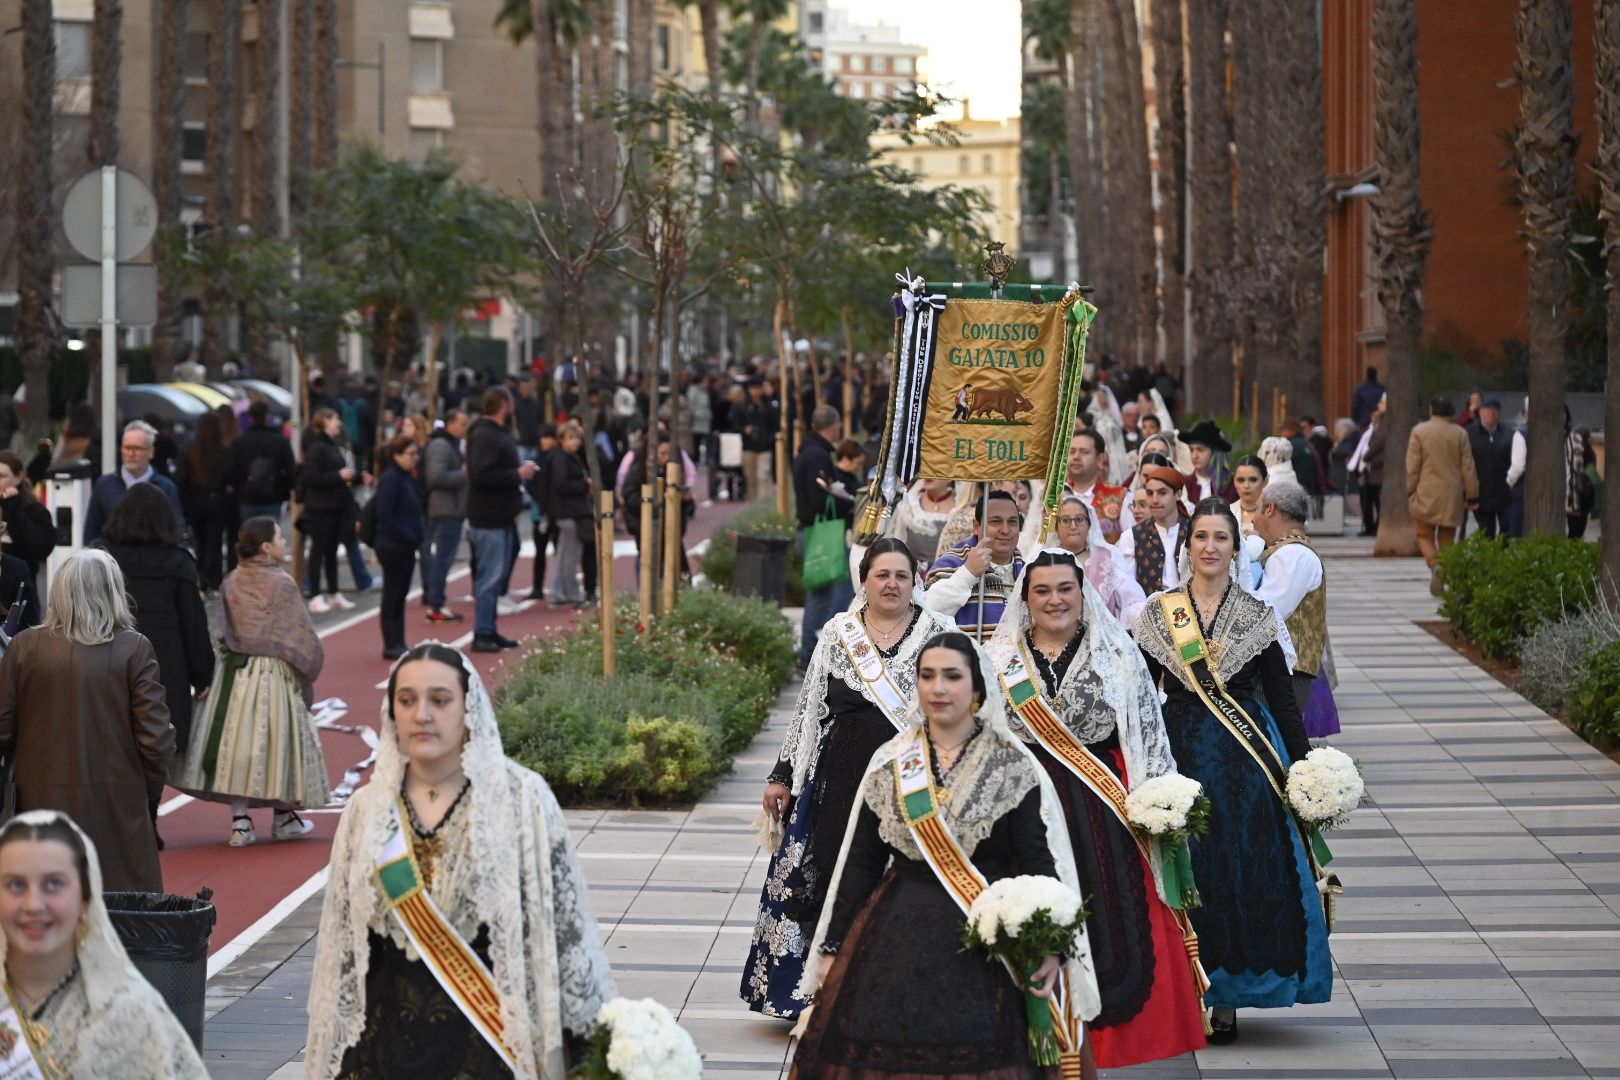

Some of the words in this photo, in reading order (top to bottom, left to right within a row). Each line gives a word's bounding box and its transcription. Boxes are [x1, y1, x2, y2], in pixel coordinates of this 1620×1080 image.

[962, 321, 1039, 341] COMISSIO
[949, 347, 1019, 368] GAIATA
[1025, 347, 1045, 367] 10
[955, 438, 976, 459] EL
[987, 440, 1029, 461] TOLL
[1200, 679, 1254, 740] Presidenta
